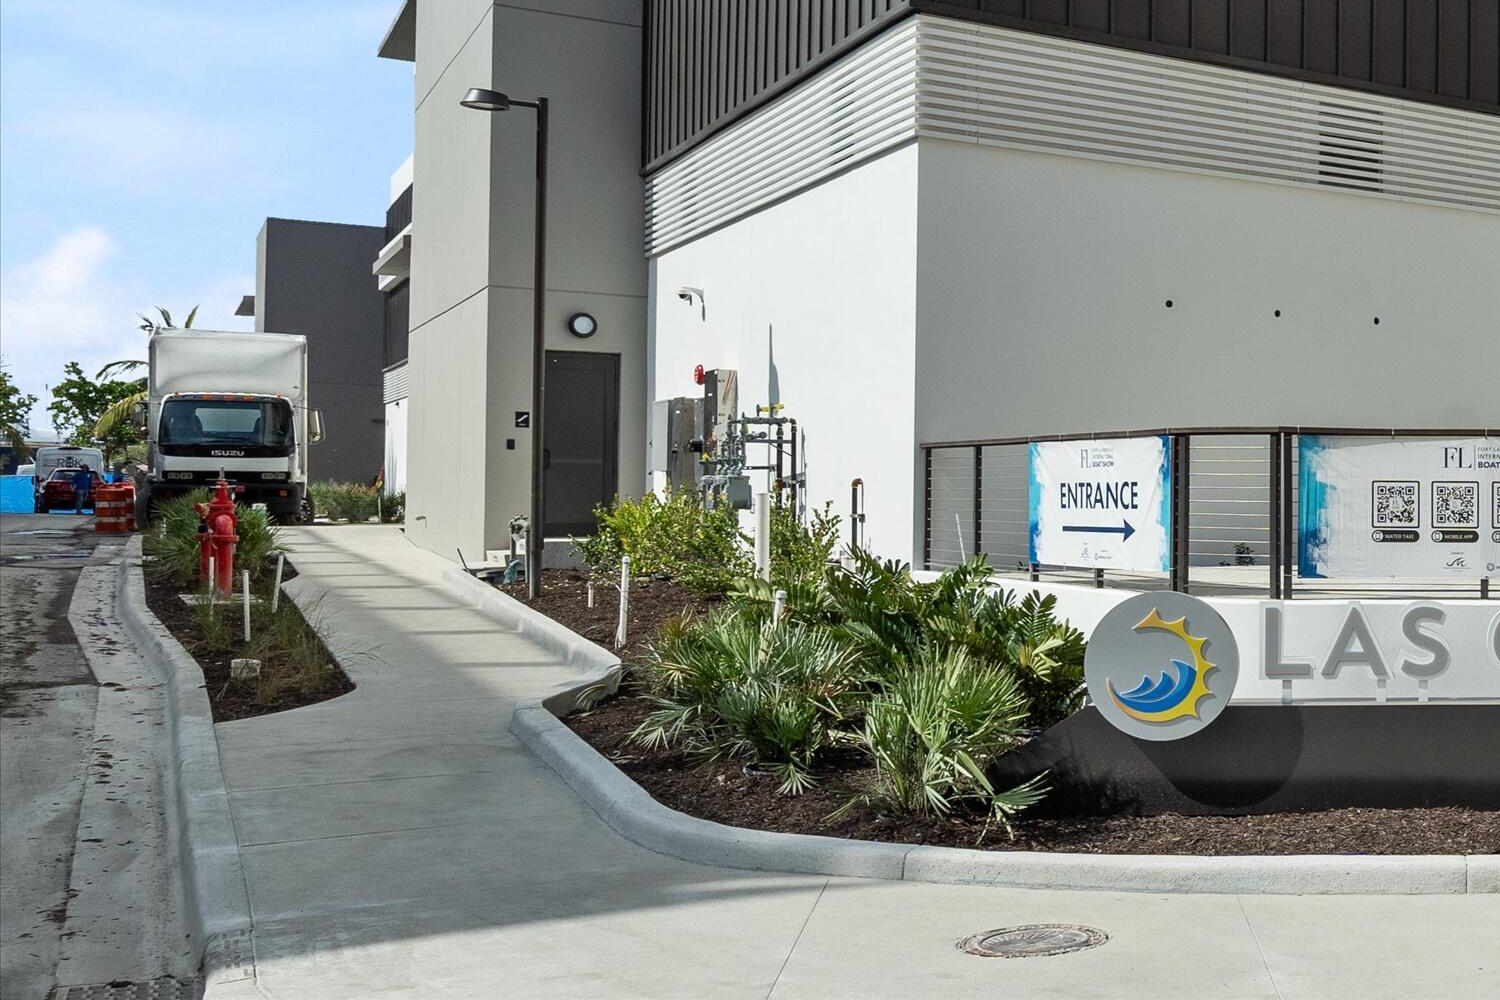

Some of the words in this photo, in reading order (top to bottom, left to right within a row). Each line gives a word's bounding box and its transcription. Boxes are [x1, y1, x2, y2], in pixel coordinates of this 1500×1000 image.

[1440, 446, 1472, 469] FL
[1060, 481, 1138, 510] ENTRANCE
[1259, 600, 1451, 680] LAS
